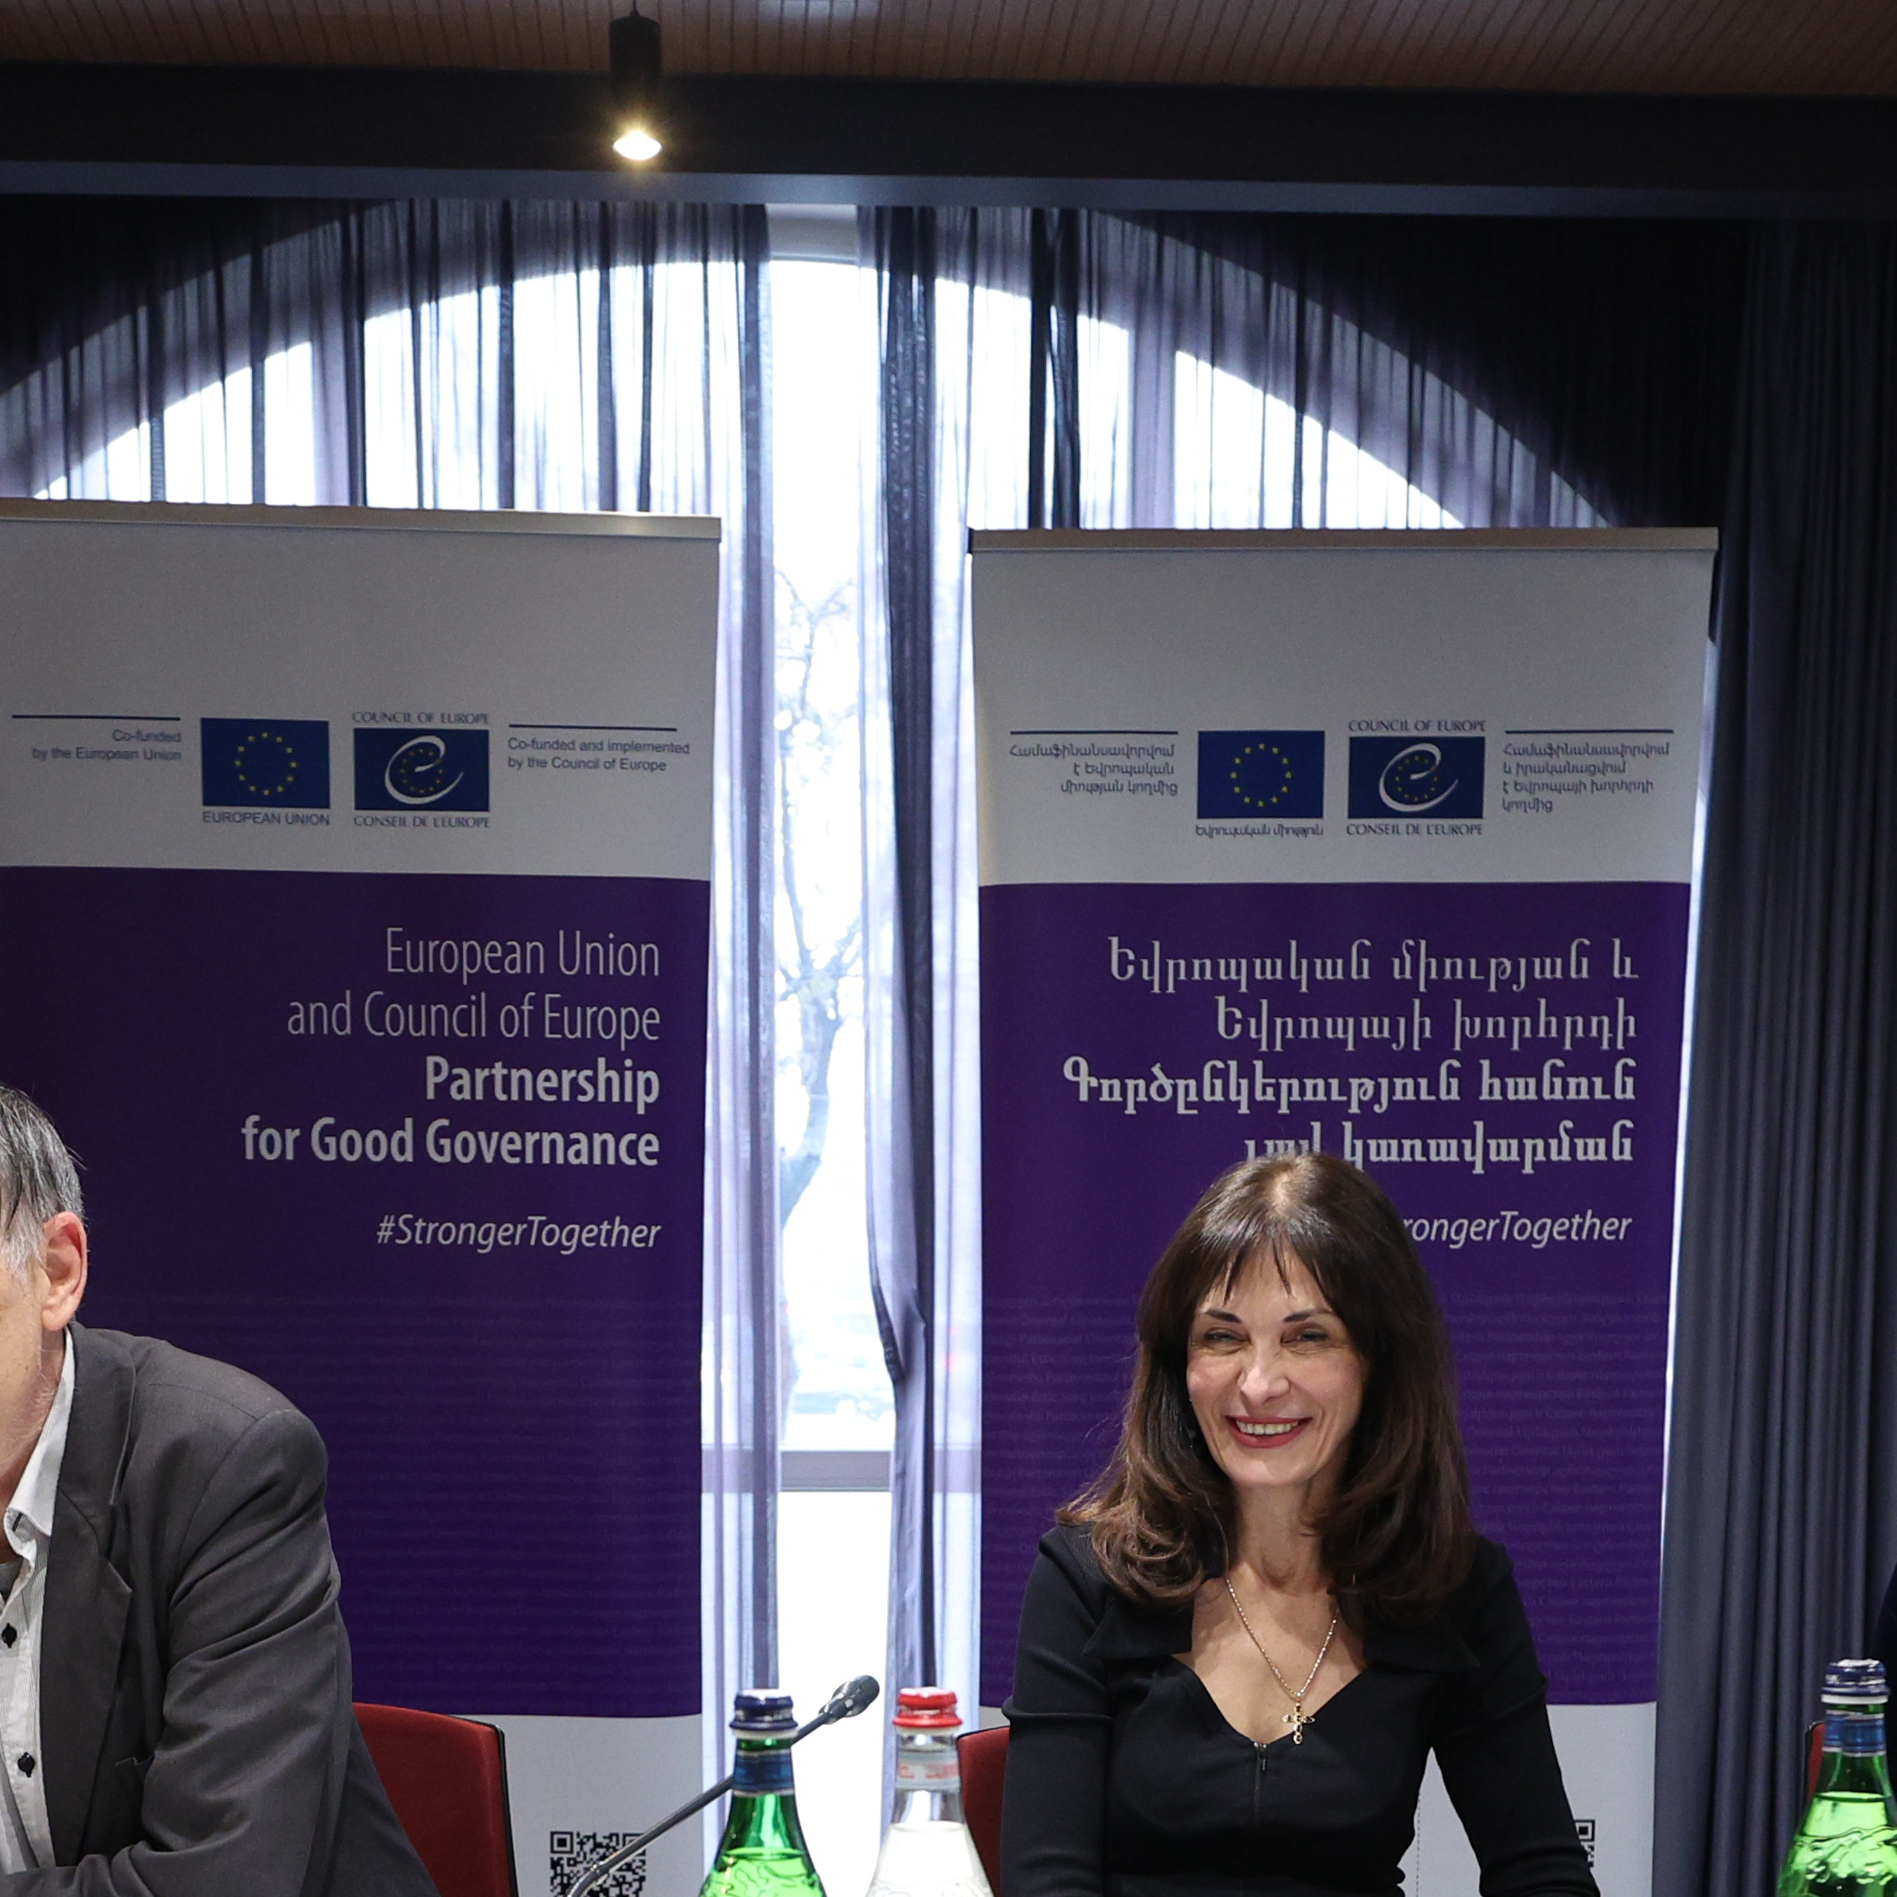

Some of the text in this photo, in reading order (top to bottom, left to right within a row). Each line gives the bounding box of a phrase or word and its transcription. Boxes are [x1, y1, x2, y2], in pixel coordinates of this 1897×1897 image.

[112, 728, 181, 743] Co-funded
[352, 712, 489, 724] COUNCIL OF EUROPE
[1348, 720, 1486, 731] COUNCIL OF EUROPE
[31, 747, 182, 763] by the European Union
[508, 737, 690, 756] Co-funded and implemented
[508, 757, 666, 772] by the Council of Europe
[203, 811, 330, 826] EUROPEAN UNION
[353, 815, 408, 827] CONSEIL
[412, 815, 429, 828] DE
[1346, 824, 1401, 835] CONSEIL
[1406, 824, 1421, 835] DE
[386, 927, 660, 985] European Union
[1108, 936, 1640, 993] Եվրոպական միության և
[288, 990, 661, 1051] and Council of Europe
[1215, 995, 1638, 1051] Եվրոպայի խորհրդի
[425, 1055, 660, 1115] Partnership
[1063, 1056, 1637, 1115] Գործընկերություն հանուն
[241, 1115, 659, 1166] for Good Governance
[1342, 1119, 1634, 1174] կառավարման
[376, 1213, 662, 1254] #StrongerTogether
[1403, 1209, 1632, 1249] rongerTogether
